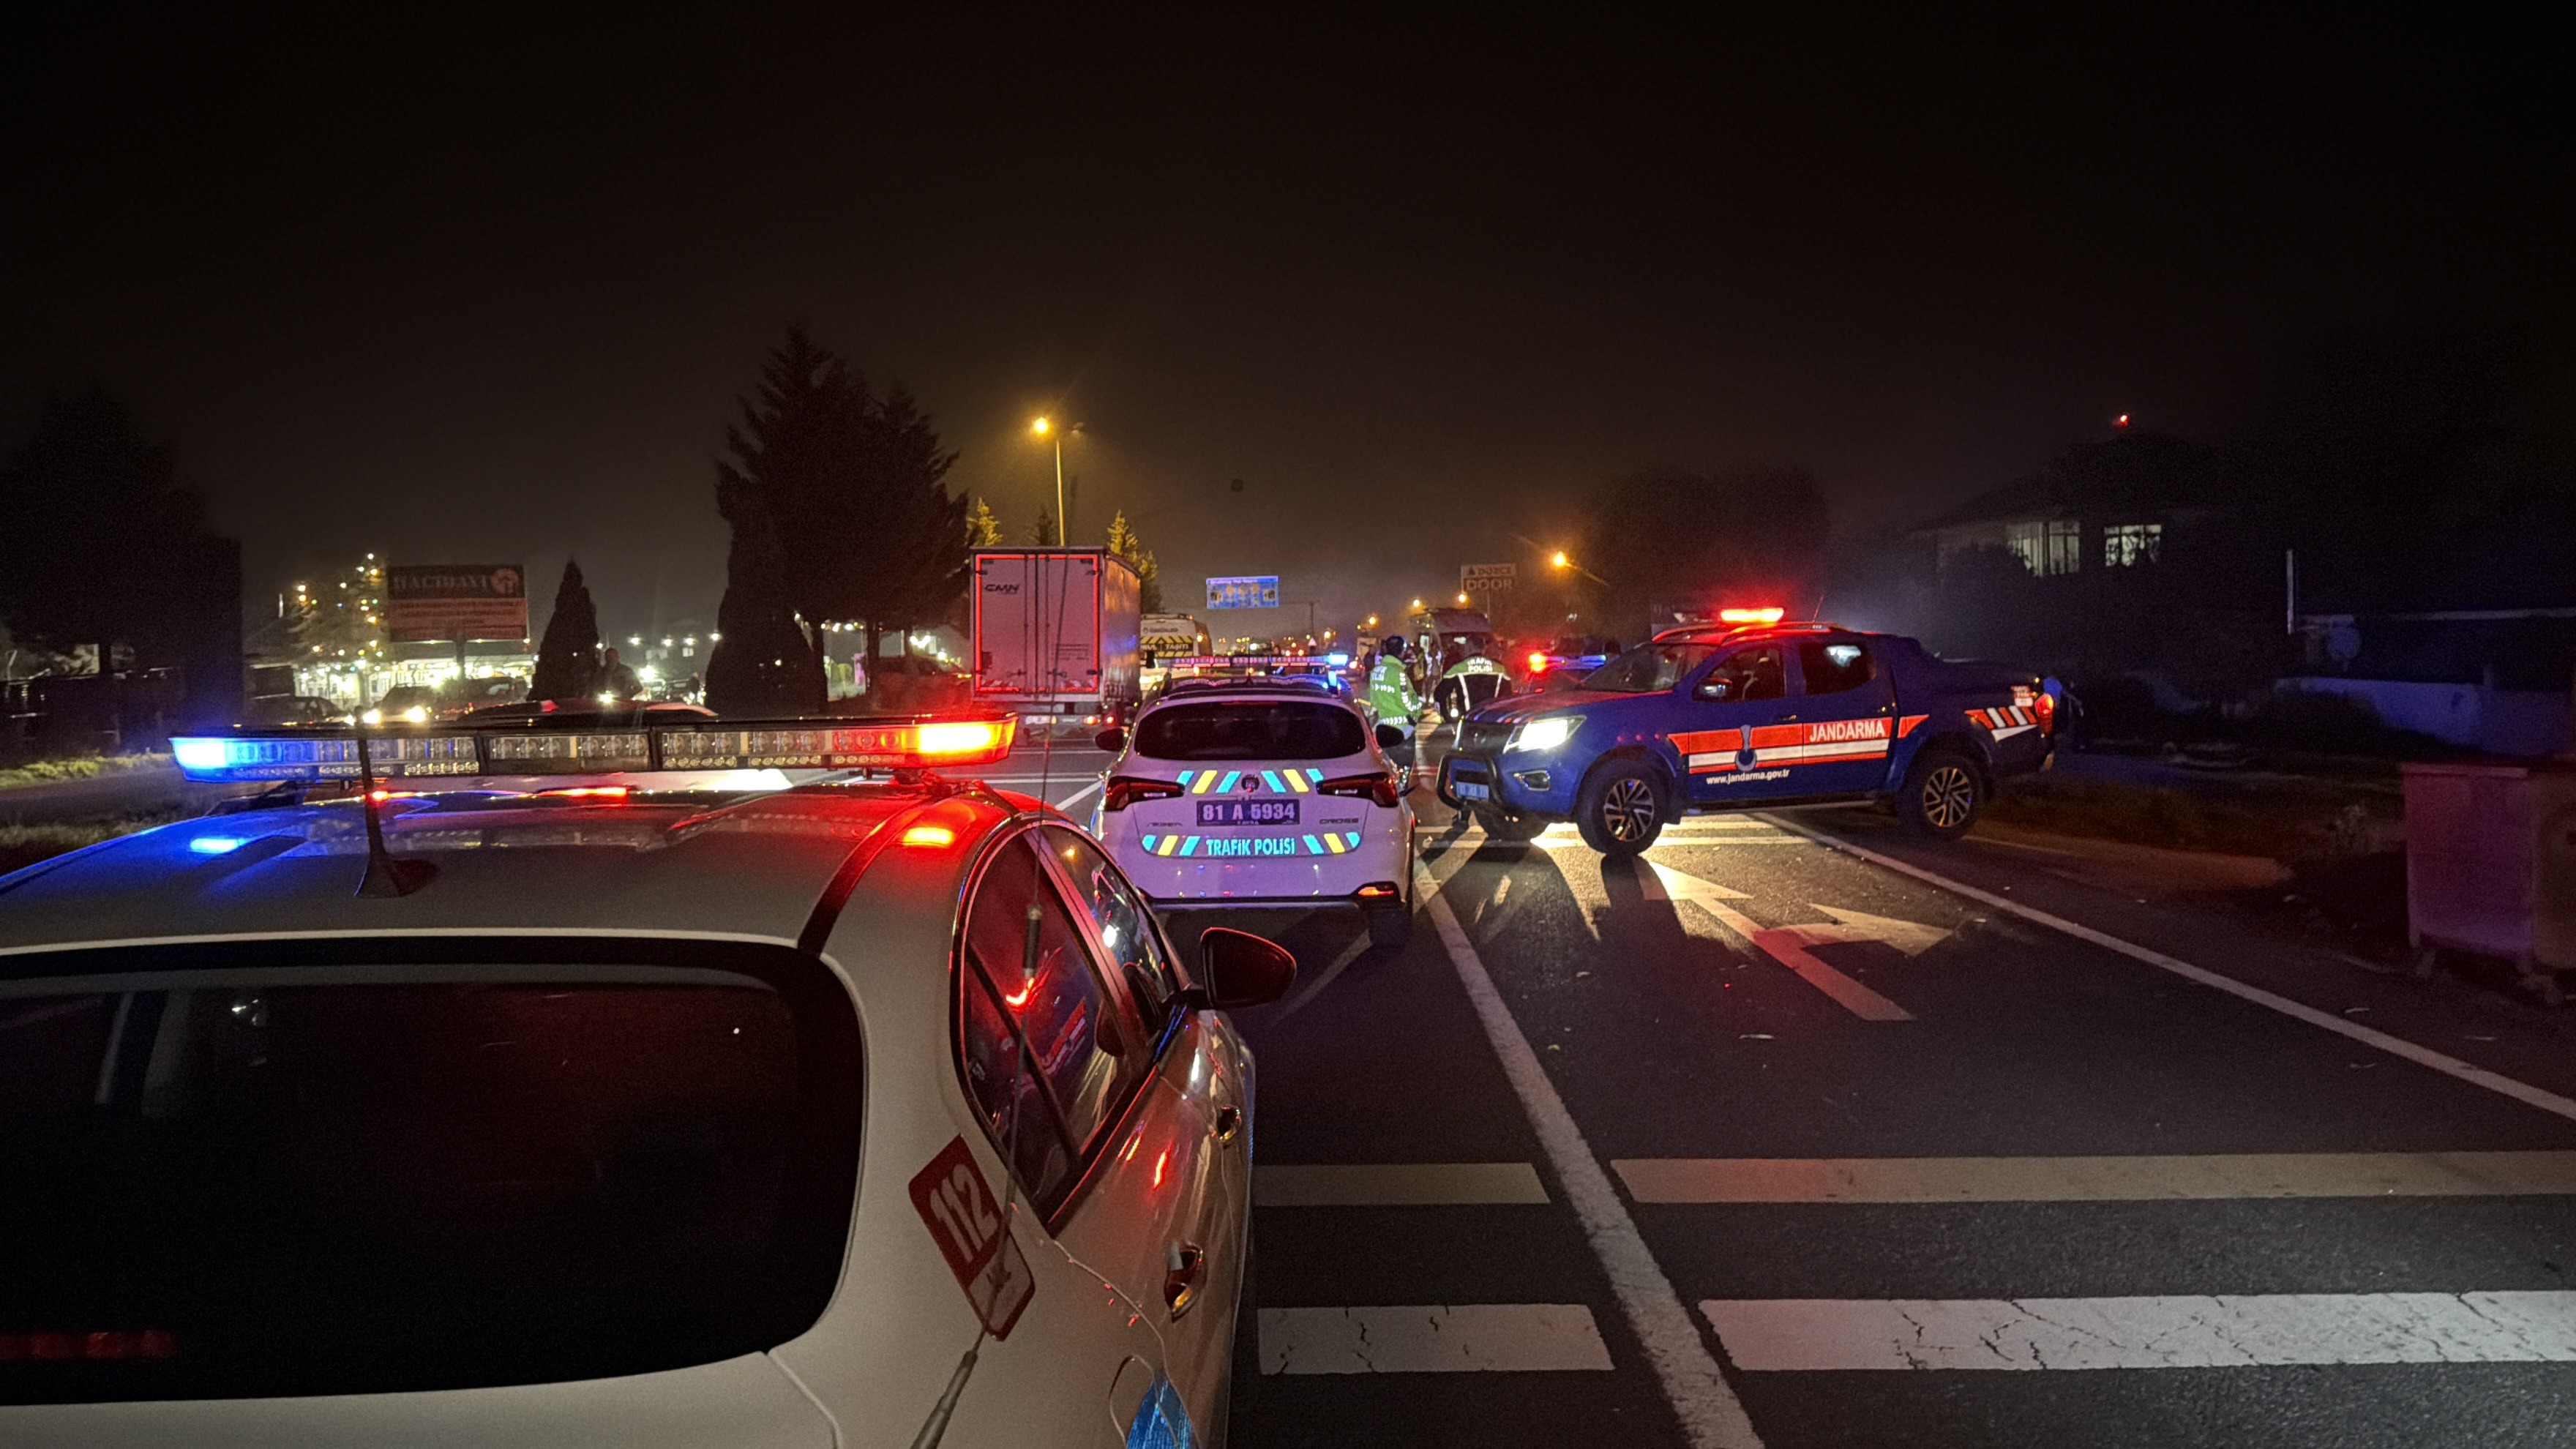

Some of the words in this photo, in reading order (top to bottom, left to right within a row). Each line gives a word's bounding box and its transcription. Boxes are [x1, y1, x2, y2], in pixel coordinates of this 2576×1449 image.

[1810, 721, 1884, 741] JANDARMA
[1707, 769, 1789, 785] www.jandarma.gov.tr
[1202, 804, 1224, 820] 81
[1232, 804, 1243, 820] A
[1251, 803, 1295, 820] 5934
[1206, 839, 1251, 856] TRAFİK
[1254, 837, 1295, 855] POLİSİ
[929, 1164, 998, 1263] 112
